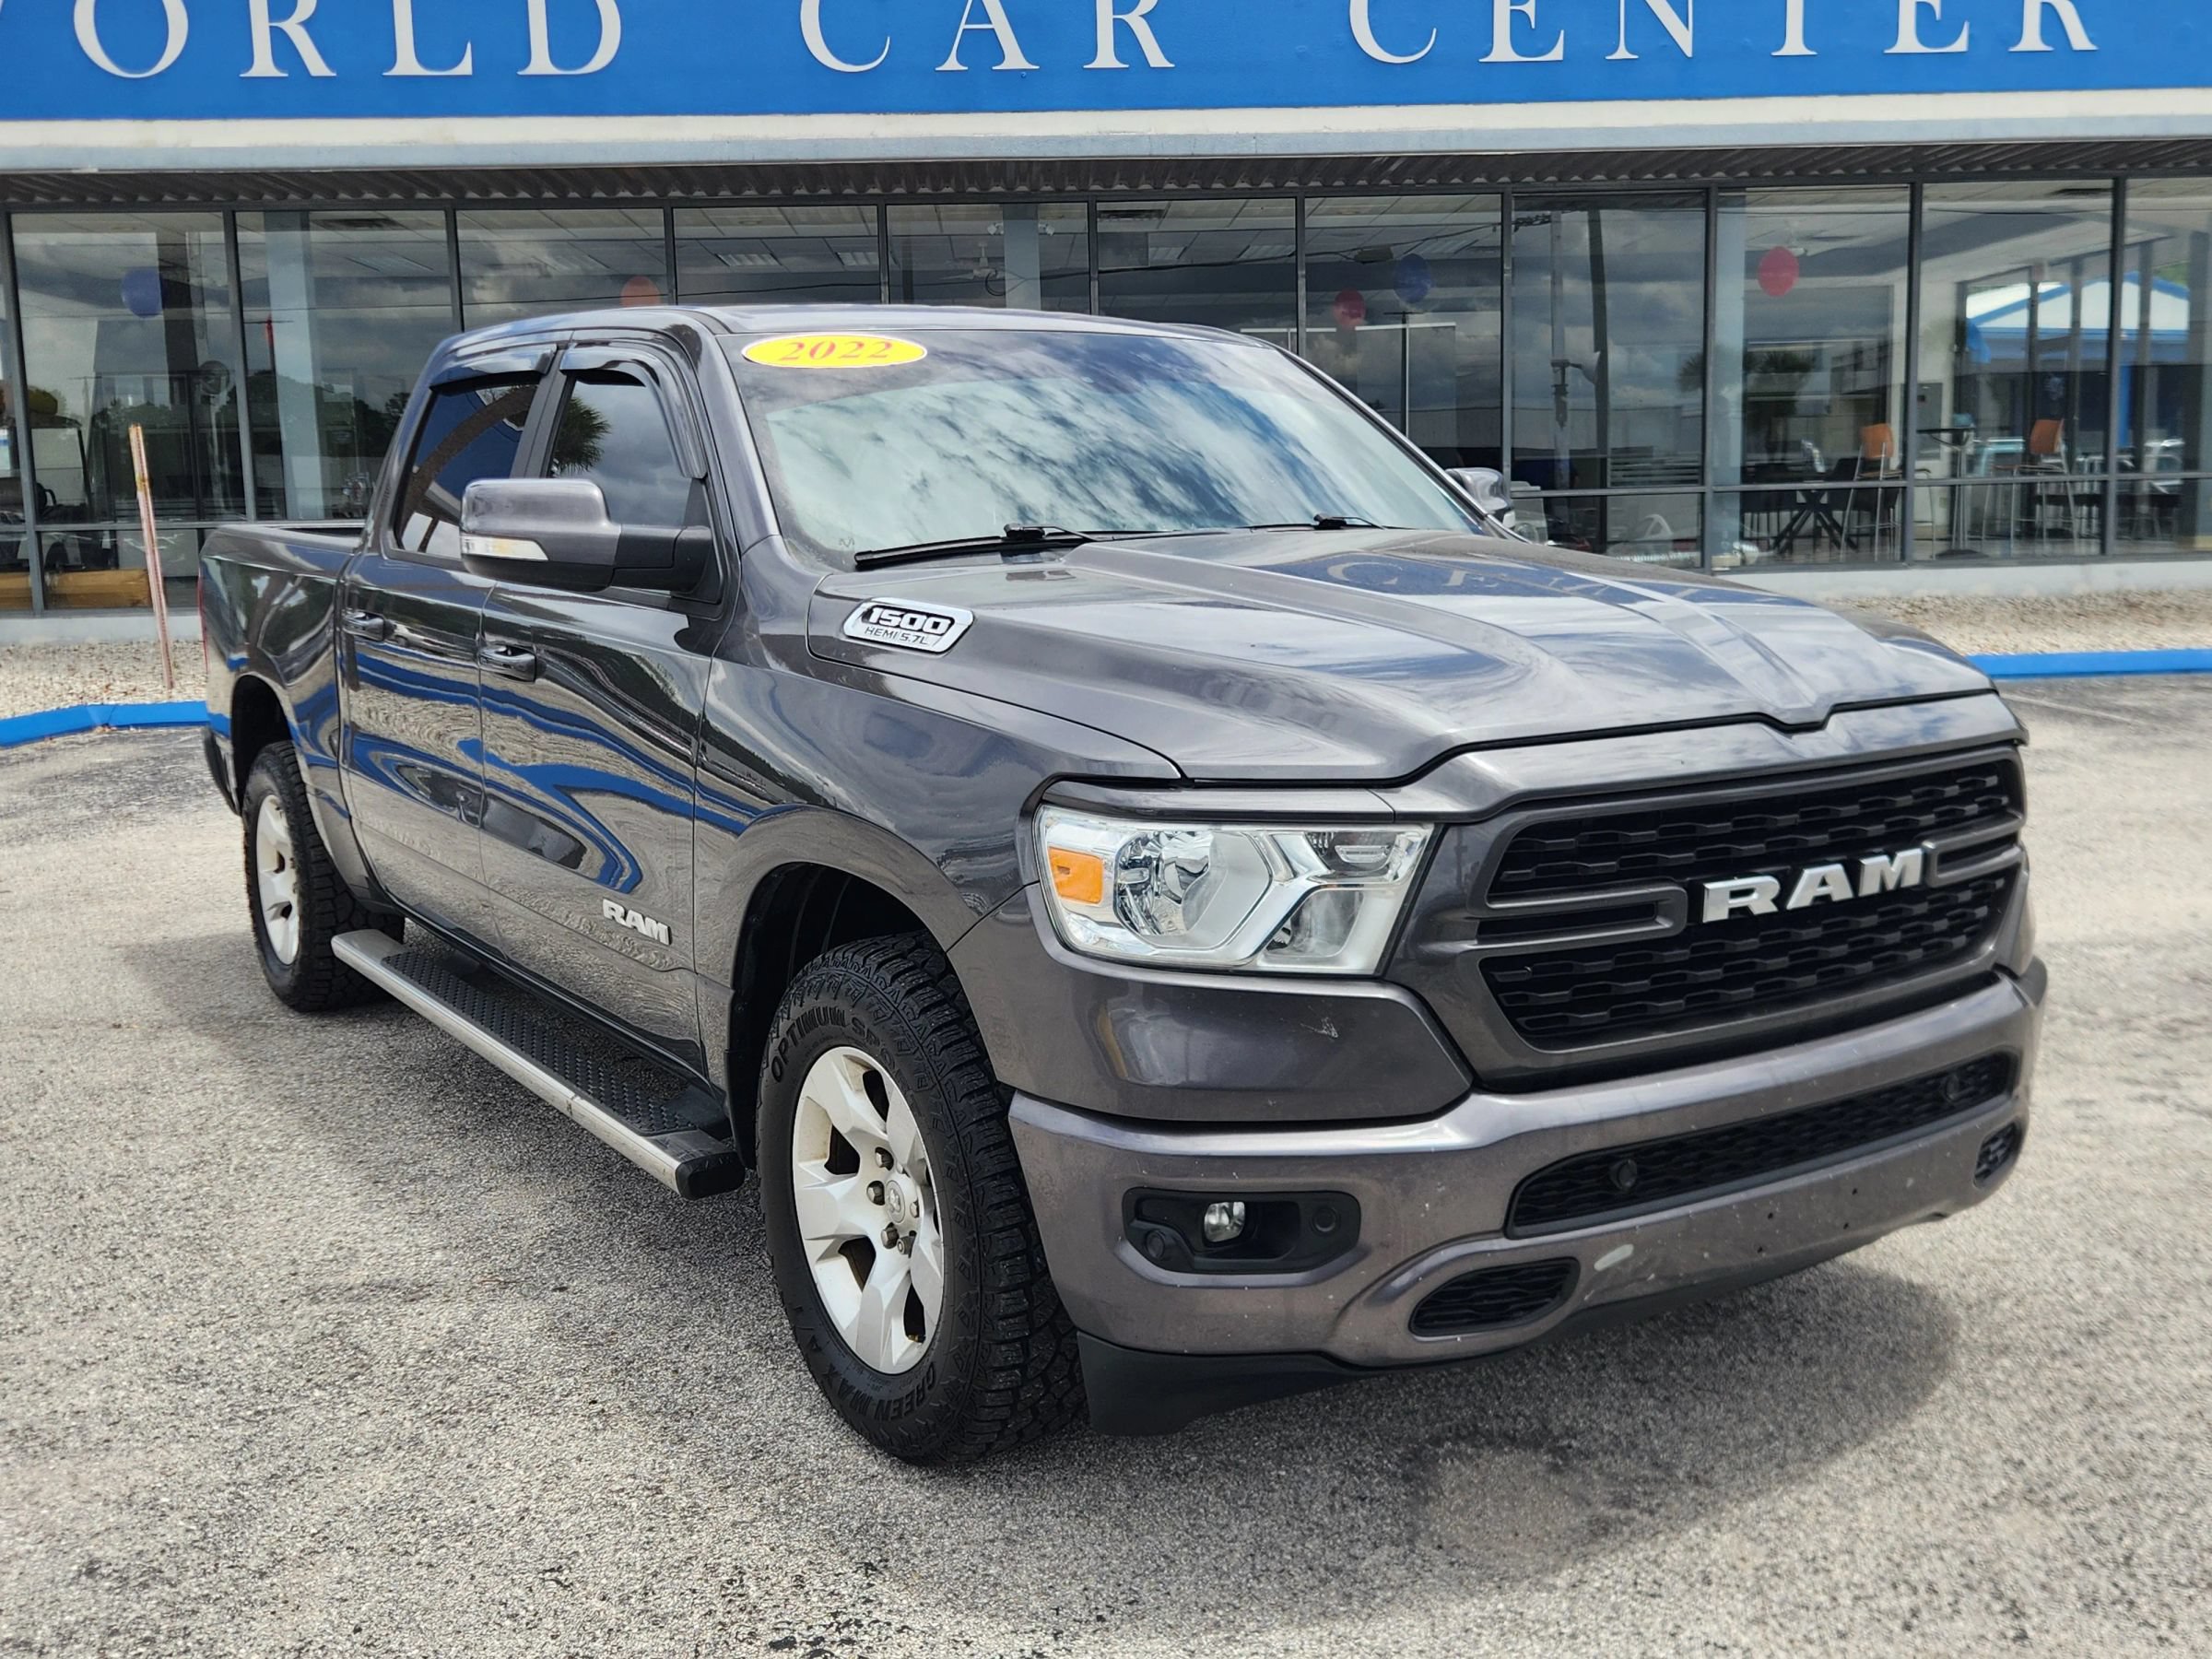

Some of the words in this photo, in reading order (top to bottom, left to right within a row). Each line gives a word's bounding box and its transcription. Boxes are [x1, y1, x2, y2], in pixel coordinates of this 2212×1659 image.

[0, 0, 622, 78] ORLD
[799, 0, 1175, 73] CAR
[778, 340, 893, 361] 2022
[865, 626, 898, 640] HEMI
[900, 632, 929, 646] 5.7L
[868, 607, 952, 635] 1500
[1702, 847, 1924, 924] RAM
[602, 898, 671, 946] RAM
[771, 1006, 847, 1083] OPTIMUM
[874, 1361, 937, 1421] GREEN
